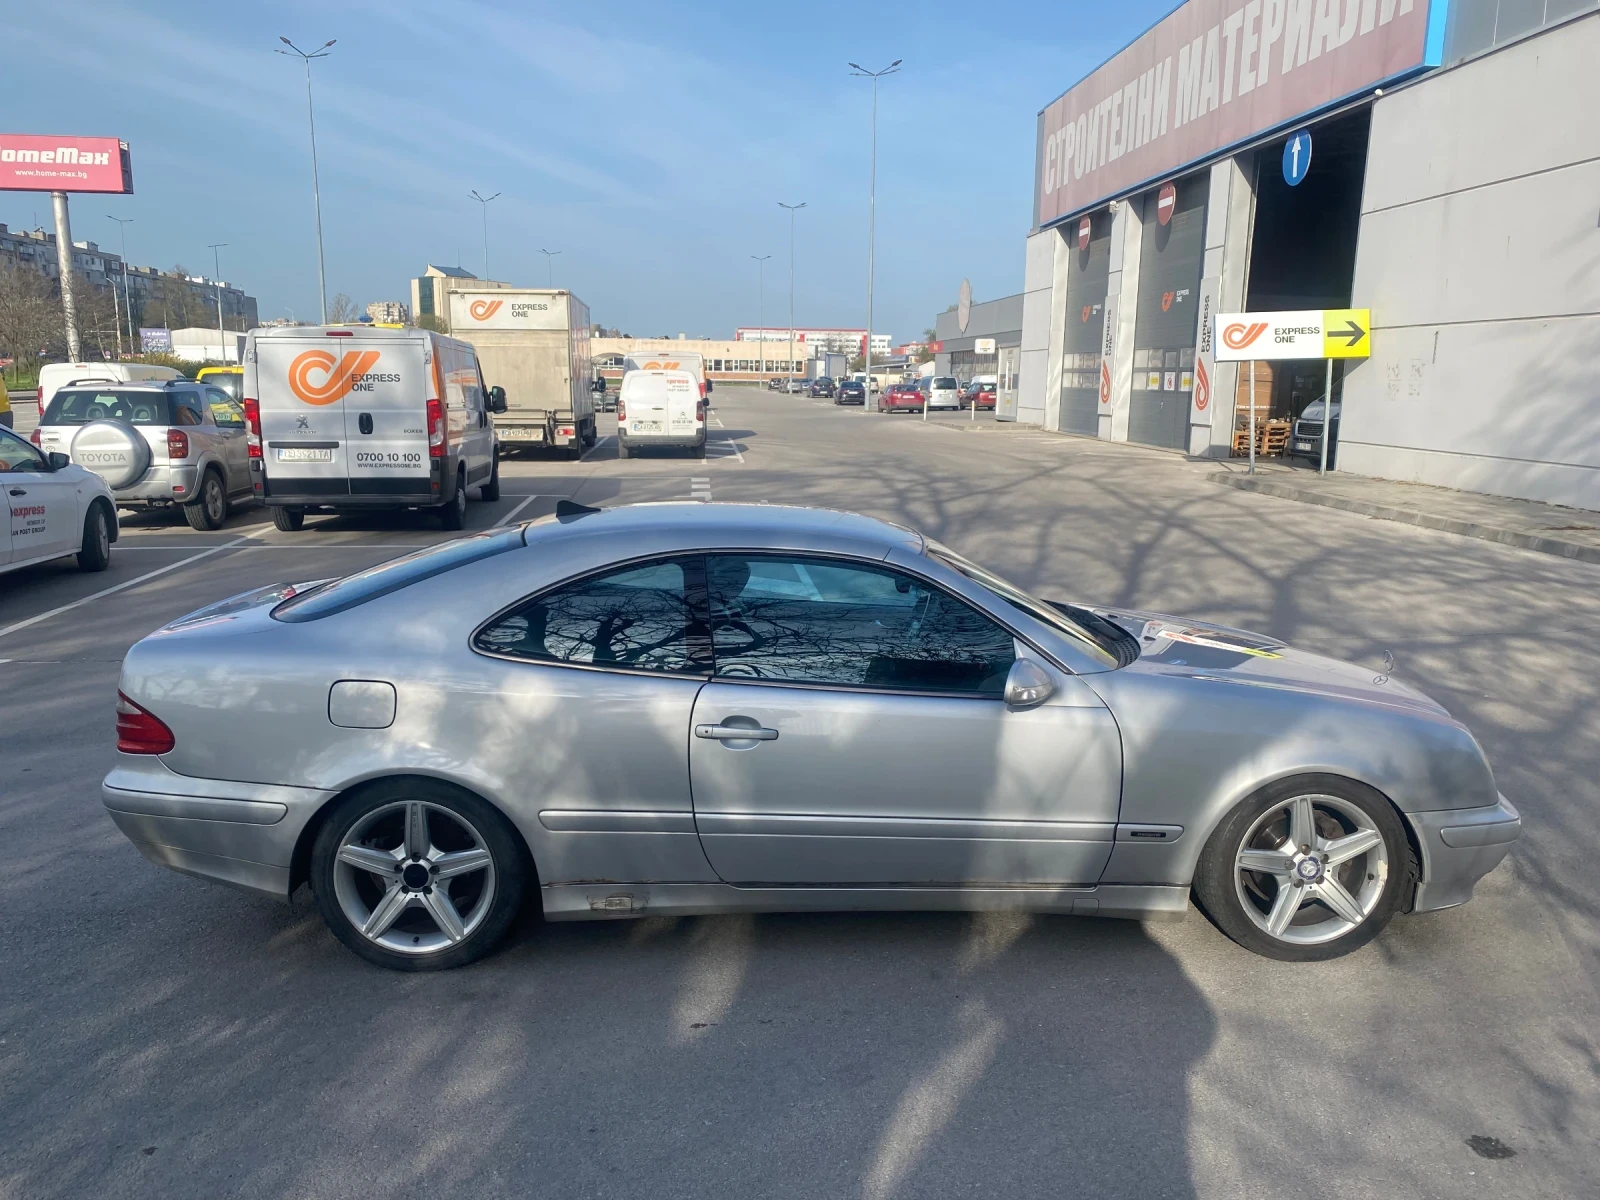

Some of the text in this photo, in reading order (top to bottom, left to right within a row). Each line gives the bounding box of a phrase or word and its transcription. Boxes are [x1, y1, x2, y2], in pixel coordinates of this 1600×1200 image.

[1044, 56, 1171, 195] СТРОИТЕЛНИ
[0, 147, 110, 165] omeMax
[15, 169, 87, 179] www.home-max.bg
[511, 303, 548, 311] EXPRESS
[511, 310, 529, 318] ONE
[1201, 294, 1210, 353] EXPRESS
[1274, 326, 1320, 335] EXPRESS
[1274, 335, 1295, 344] ONE
[351, 373, 401, 383] EXPRESS
[351, 382, 375, 392] ONE
[79, 453, 127, 462] TOYOTA
[356, 452, 421, 462] 0700 10 100
[13, 505, 46, 519] express
[31, 526, 46, 534] GROUP
